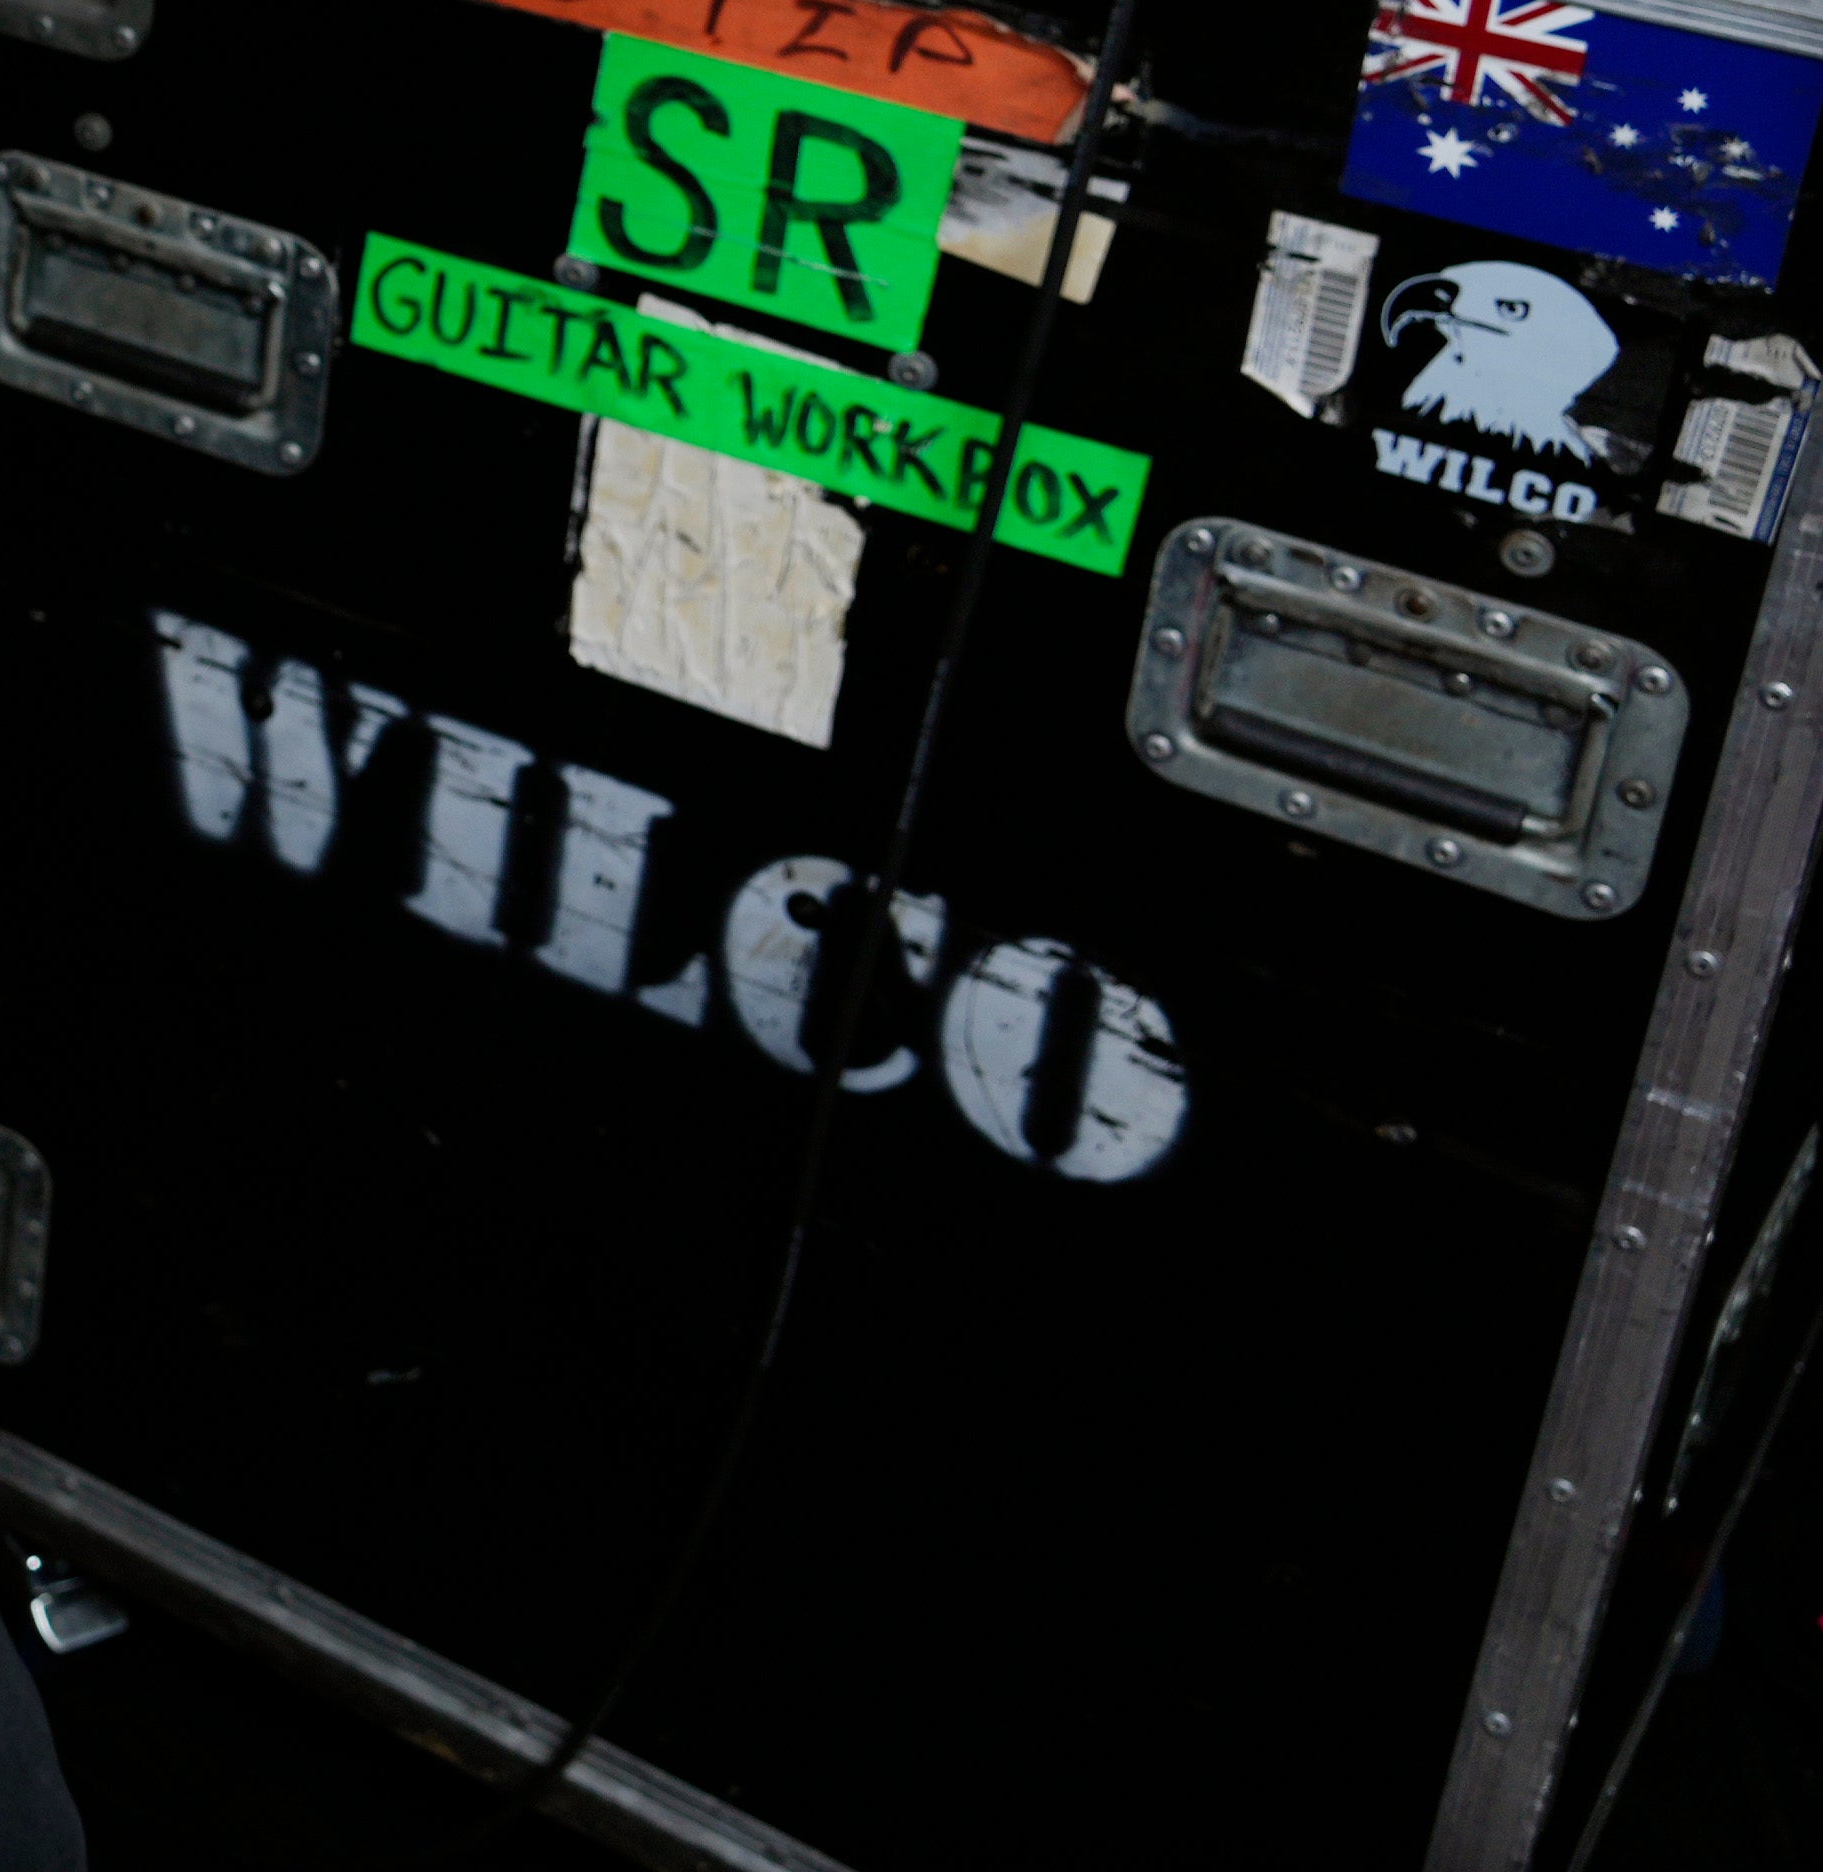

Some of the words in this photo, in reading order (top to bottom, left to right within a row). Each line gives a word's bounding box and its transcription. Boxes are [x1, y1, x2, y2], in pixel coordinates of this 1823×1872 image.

[598, 76, 902, 322] SR
[367, 256, 688, 418] GUITAR
[1372, 429, 1596, 523] WILCO
[152, 609, 1190, 1184] WILCO
